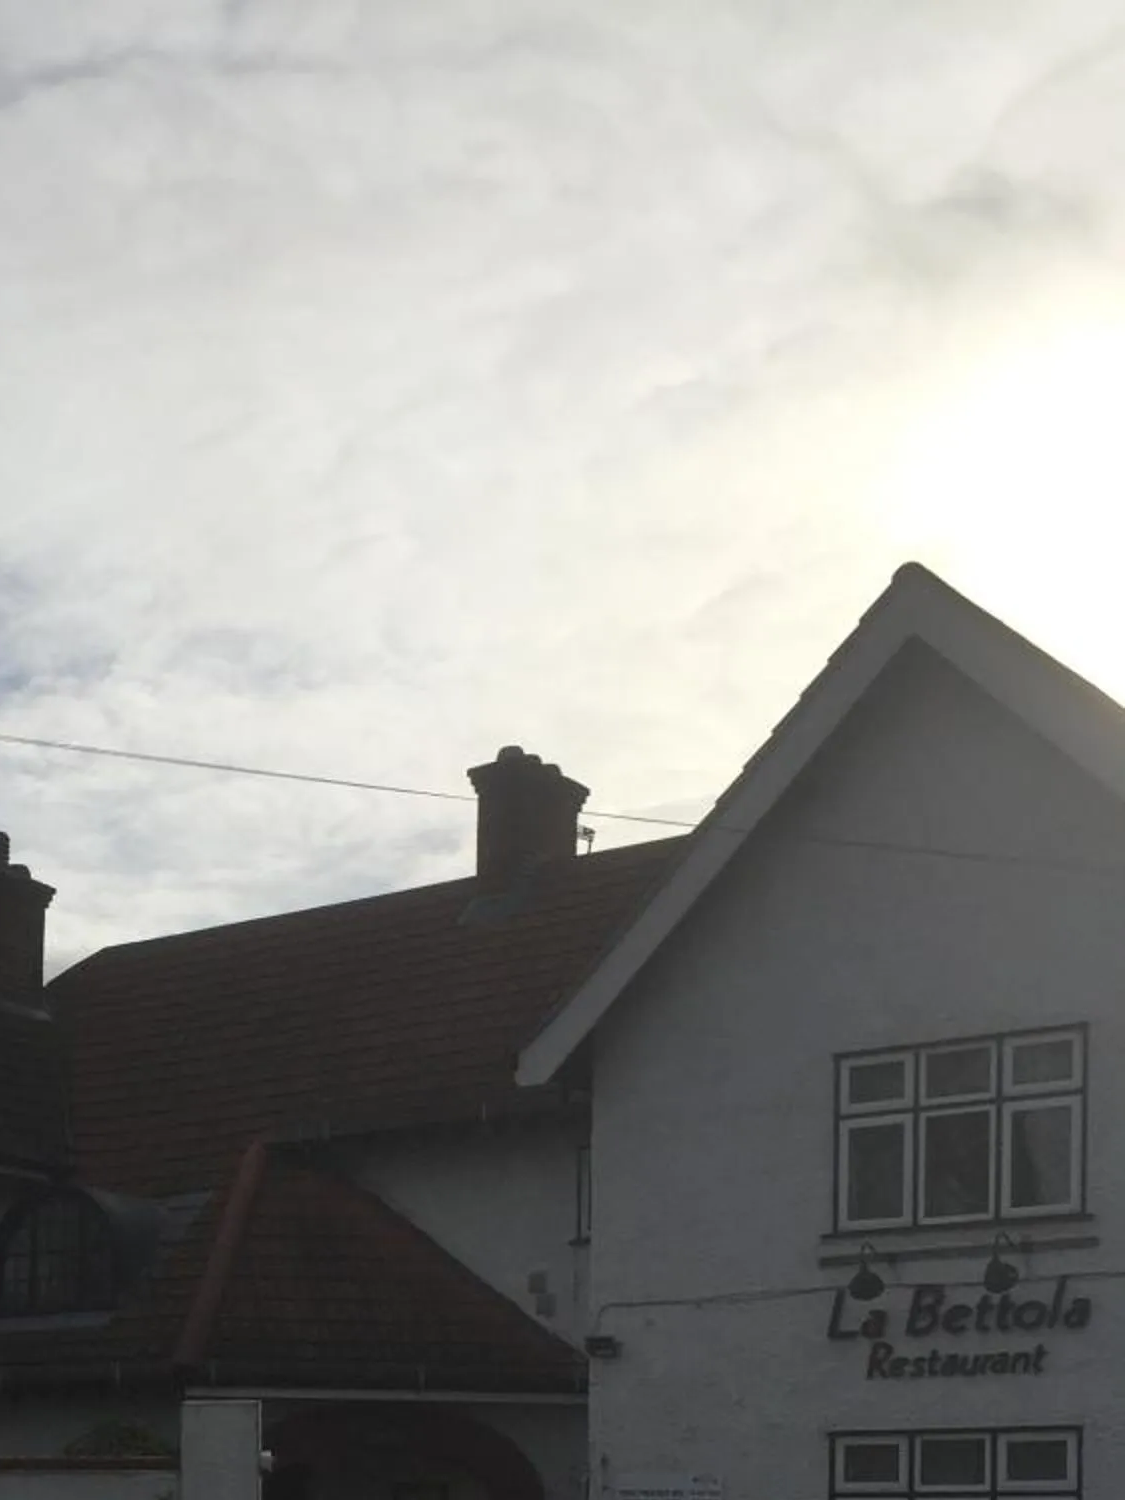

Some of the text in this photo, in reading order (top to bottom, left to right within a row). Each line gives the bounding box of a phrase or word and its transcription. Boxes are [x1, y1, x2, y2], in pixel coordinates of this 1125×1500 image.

[828, 1276, 1092, 1339] La Bettola
[867, 1342, 1049, 1379] Restaurant
